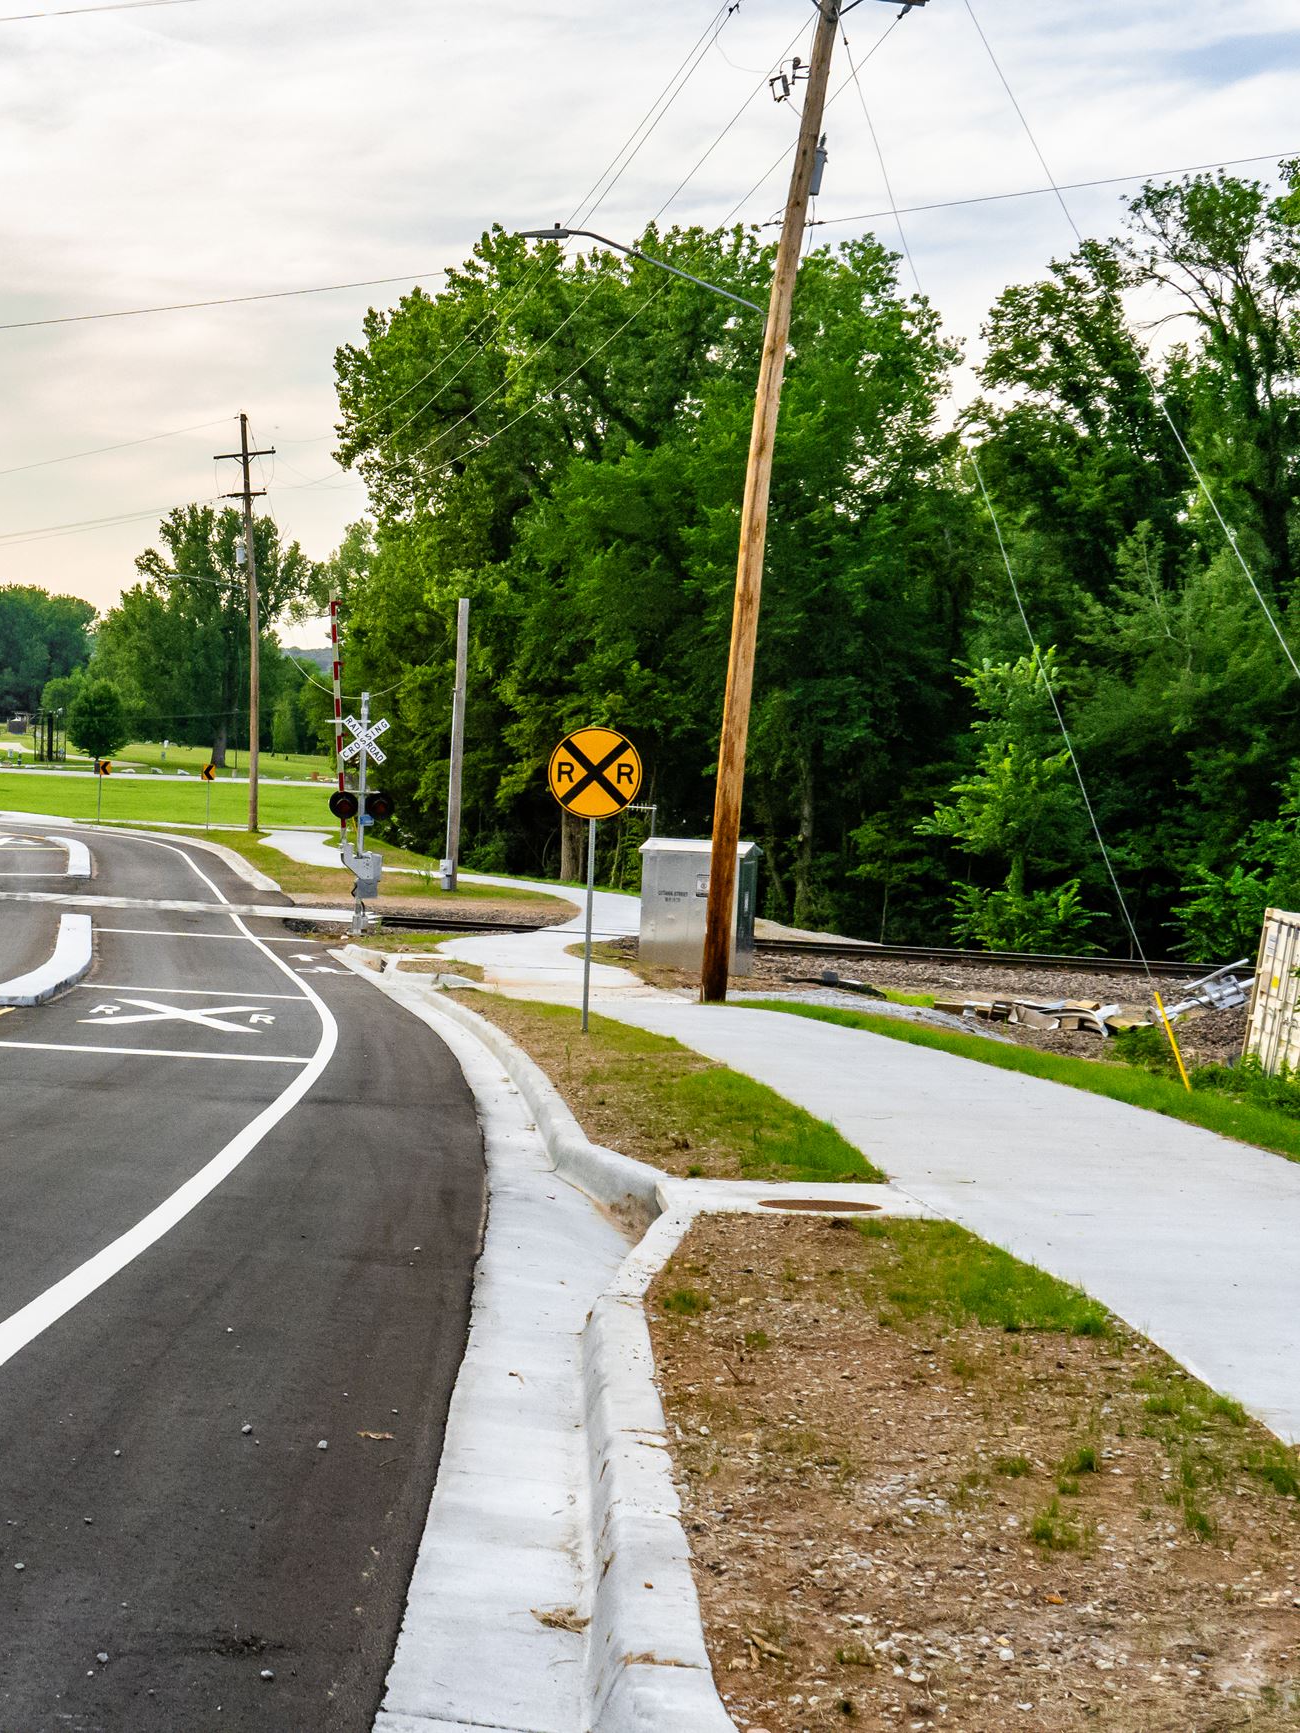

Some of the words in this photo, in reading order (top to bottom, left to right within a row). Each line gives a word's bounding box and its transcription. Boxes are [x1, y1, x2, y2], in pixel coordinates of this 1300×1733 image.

[342, 721, 388, 758] CROSSING
[345, 717, 384, 762] RAILROAD
[557, 762, 575, 782] R
[616, 763, 634, 784] R
[89, 1005, 121, 1014] R
[249, 1014, 276, 1025] R
